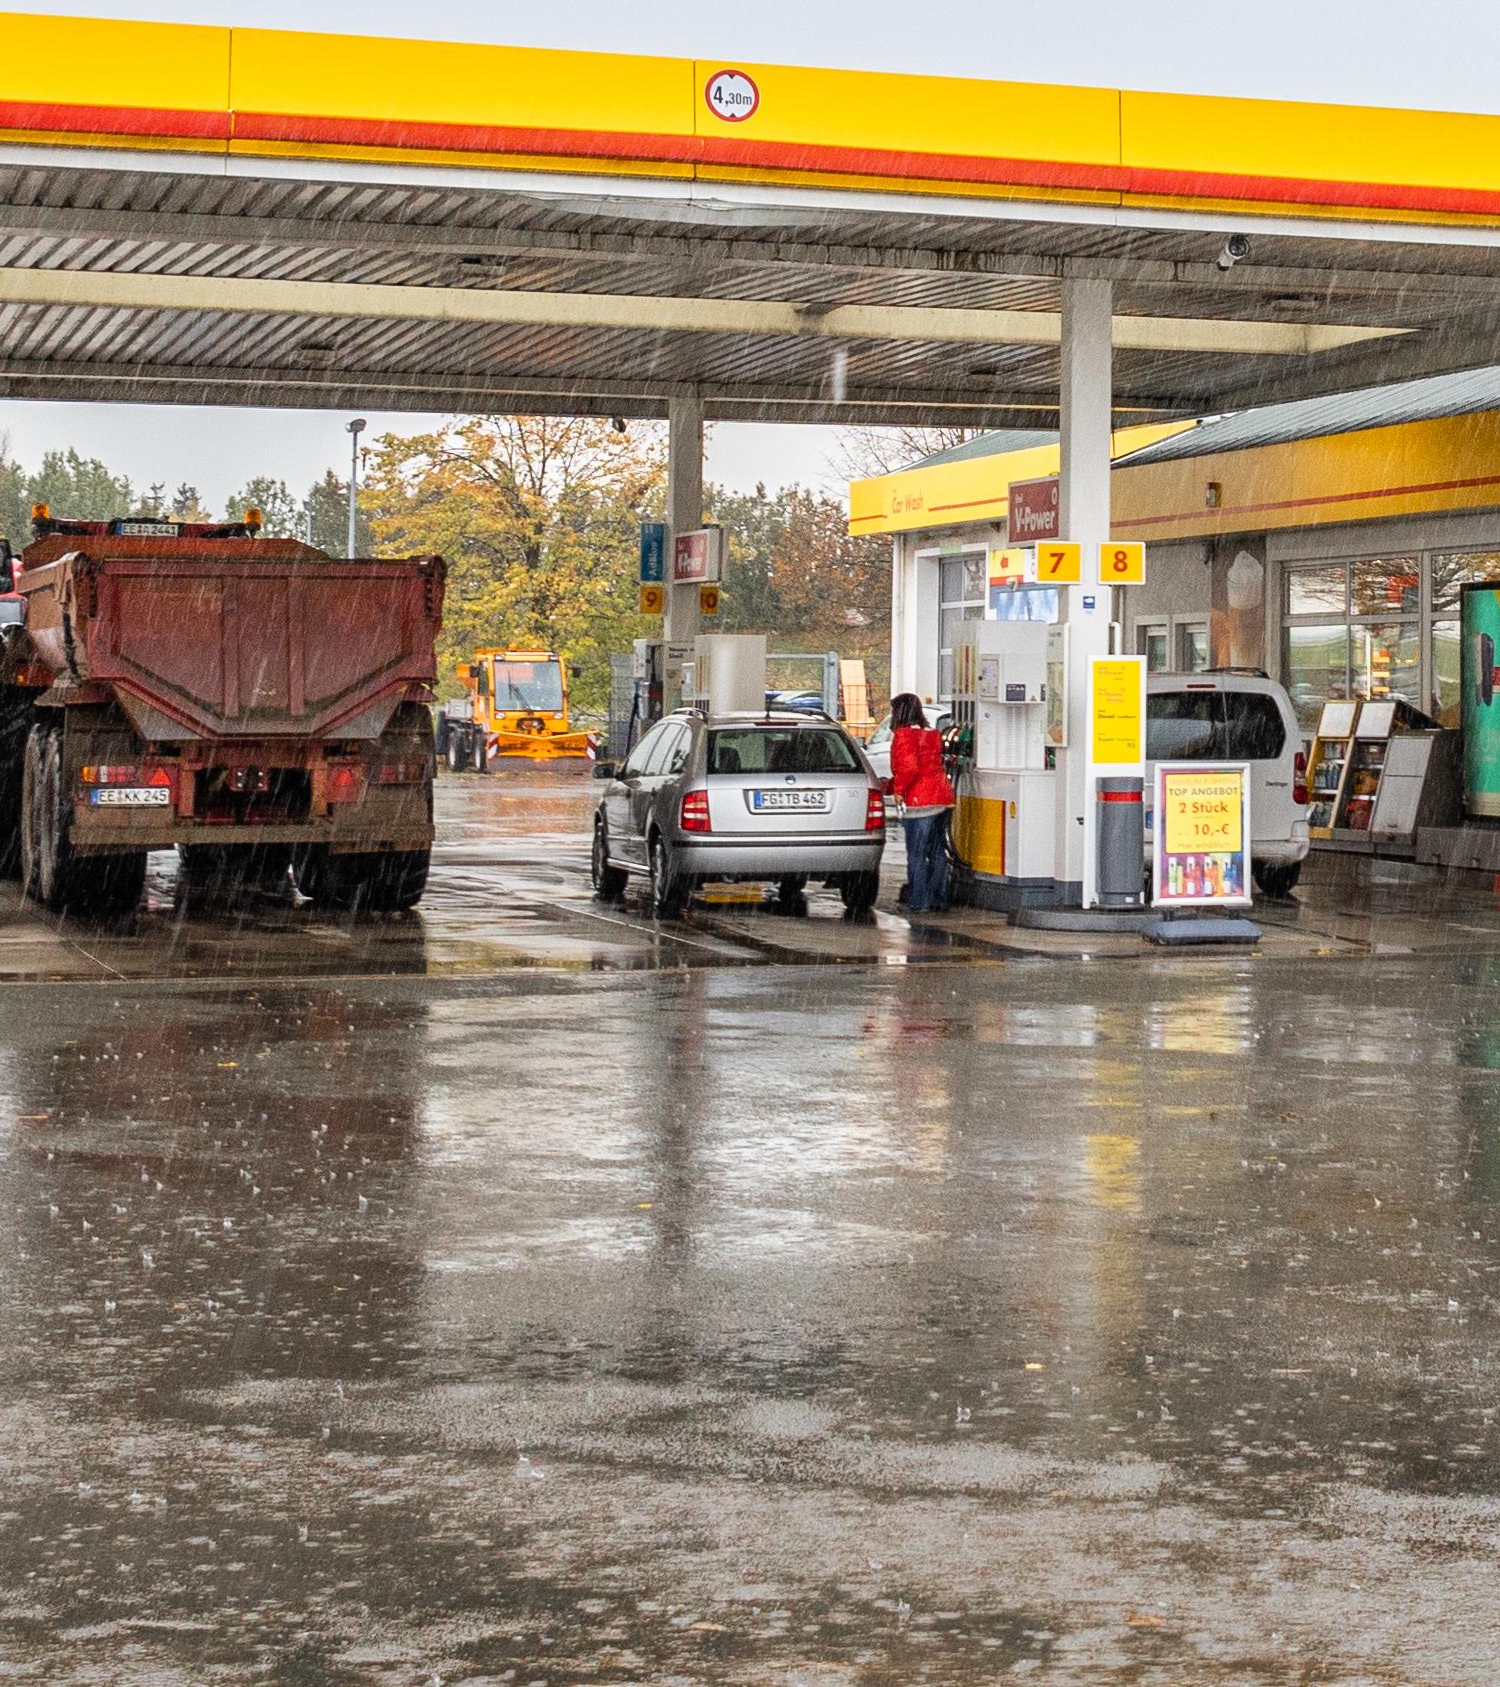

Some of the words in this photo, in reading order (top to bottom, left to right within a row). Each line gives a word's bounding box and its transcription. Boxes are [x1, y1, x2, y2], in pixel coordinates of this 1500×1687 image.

[713, 85, 753, 108] 4,30m
[1014, 508, 1056, 533] V-Power
[1050, 552, 1065, 574] 7
[1113, 550, 1128, 573] 8
[644, 591, 658, 607] 9
[99, 790, 116, 803] EE
[124, 790, 141, 802] KK
[143, 789, 167, 802] 245
[762, 793, 777, 805] FG
[785, 793, 800, 805] TB
[803, 792, 825, 805] 462
[1169, 788, 1188, 796] TOP
[1191, 787, 1238, 796] ANGEBOT
[1178, 802, 1187, 814] 2
[1192, 800, 1229, 813] Stück
